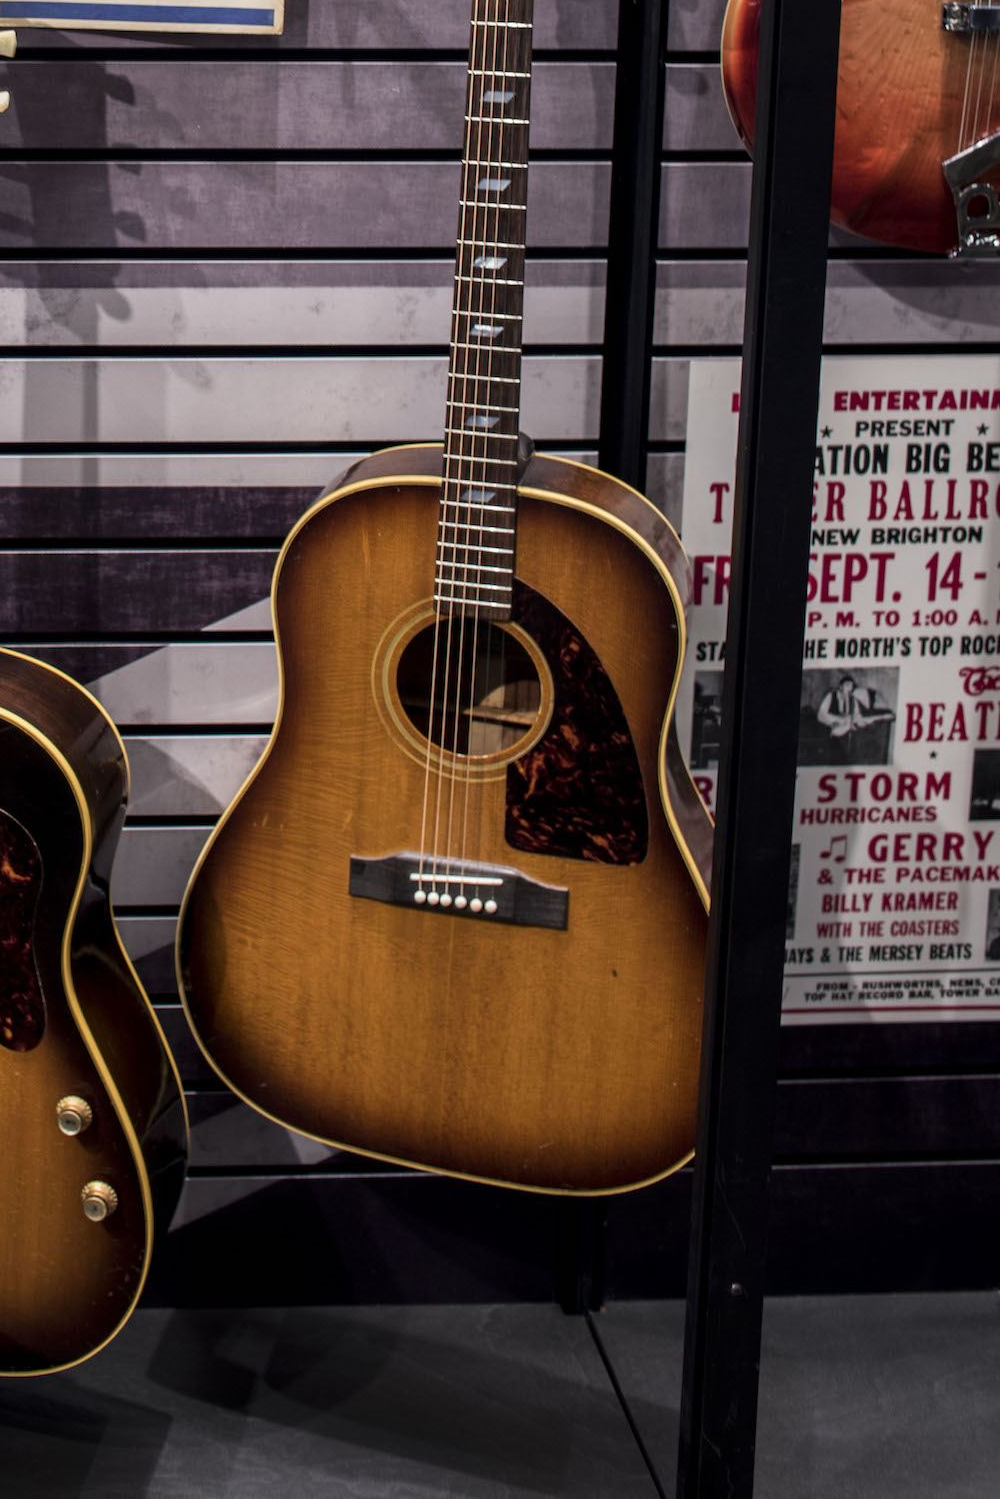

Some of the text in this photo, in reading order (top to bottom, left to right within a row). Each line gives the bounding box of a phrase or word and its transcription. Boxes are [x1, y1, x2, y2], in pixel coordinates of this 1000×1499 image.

[855, 419, 955, 438] PRESENT
[814, 442, 1000, 476] ATION BIG BE
[867, 479, 1000, 522] BALLR
[811, 526, 983, 546] NEW BRIGHTON
[925, 551, 963, 602] 14
[872, 610, 900, 628] TO
[912, 609, 958, 627] 1:00
[804, 638, 827, 659] HE
[835, 636, 911, 659] NORTH'S
[918, 636, 953, 657] TOP
[903, 701, 1000, 743] BEAT
[817, 772, 952, 803] STORM
[800, 806, 937, 825] HURRICANES
[868, 831, 995, 863] GERRY
[817, 866, 1000, 885] & THE PACEMAK
[821, 891, 958, 913] BILLY KRAMER
[816, 919, 959, 939] WITH THE COASTERS
[820, 947, 831, 964] &
[837, 946, 863, 963] THE
[869, 944, 923, 961] MERSEY
[929, 943, 972, 960] BEATS
[804, 992, 826, 1003] TOP
[831, 991, 853, 1001] HAT
[858, 989, 903, 1001] RECORD
[940, 987, 979, 998] TOWER
[816, 981, 848, 991] FROM
